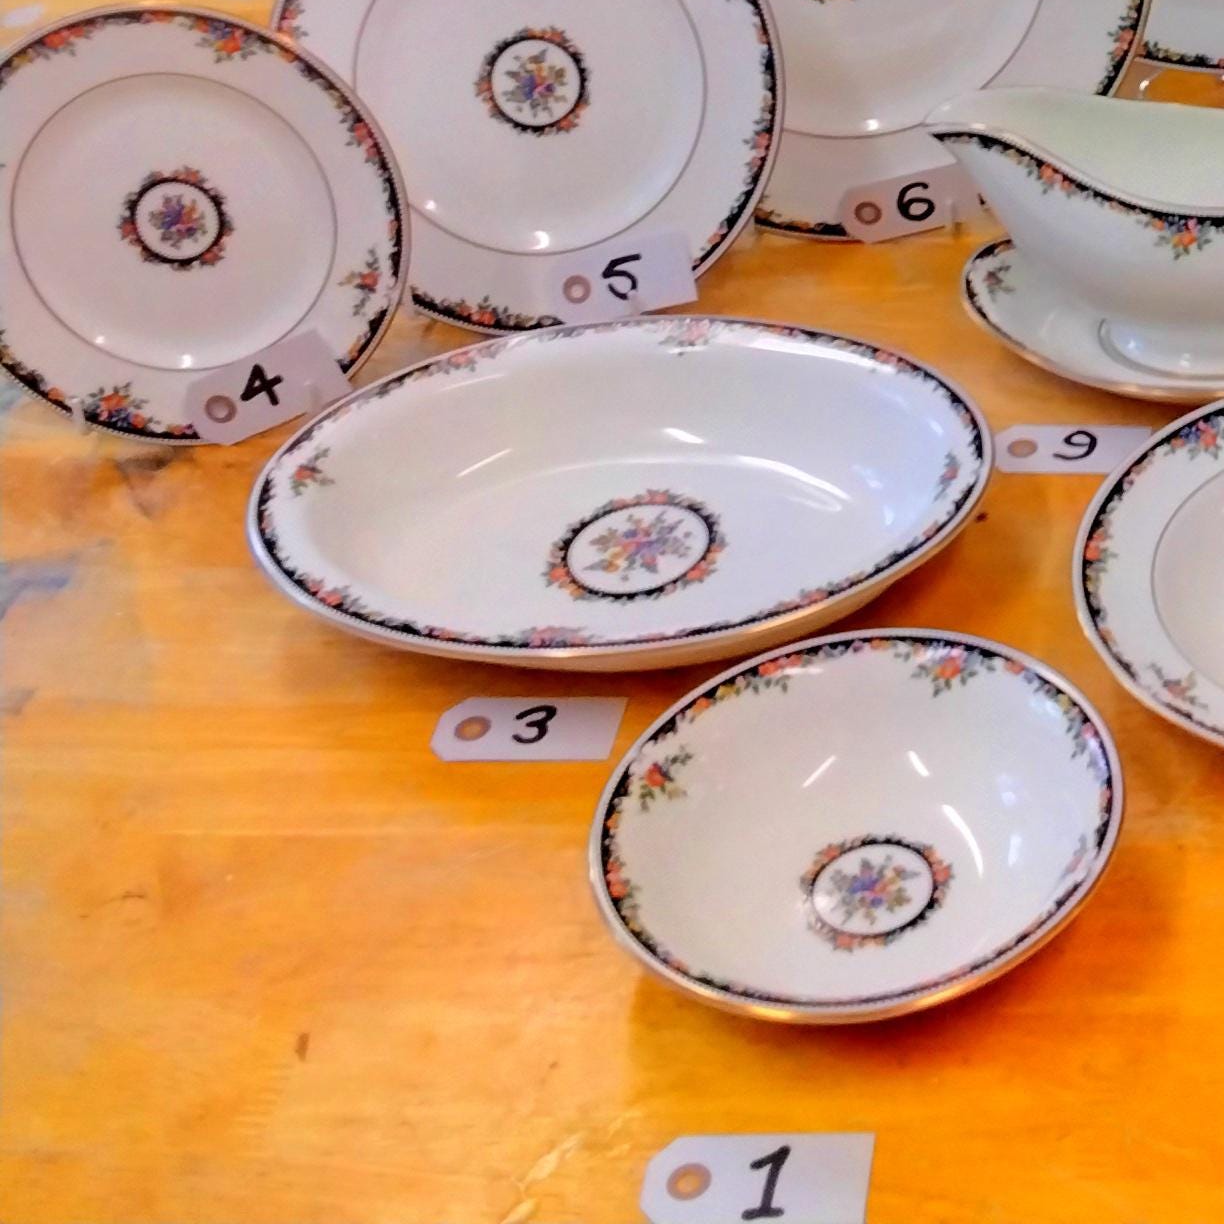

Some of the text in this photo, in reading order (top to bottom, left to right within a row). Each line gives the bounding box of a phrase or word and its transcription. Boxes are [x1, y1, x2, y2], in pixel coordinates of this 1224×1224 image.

[895, 180, 938, 223] 6
[601, 253, 642, 301] 5
[240, 363, 284, 407] 4
[1053, 429, 1099, 461] 9
[511, 705, 557, 745] 3
[741, 1144, 792, 1221] 1
